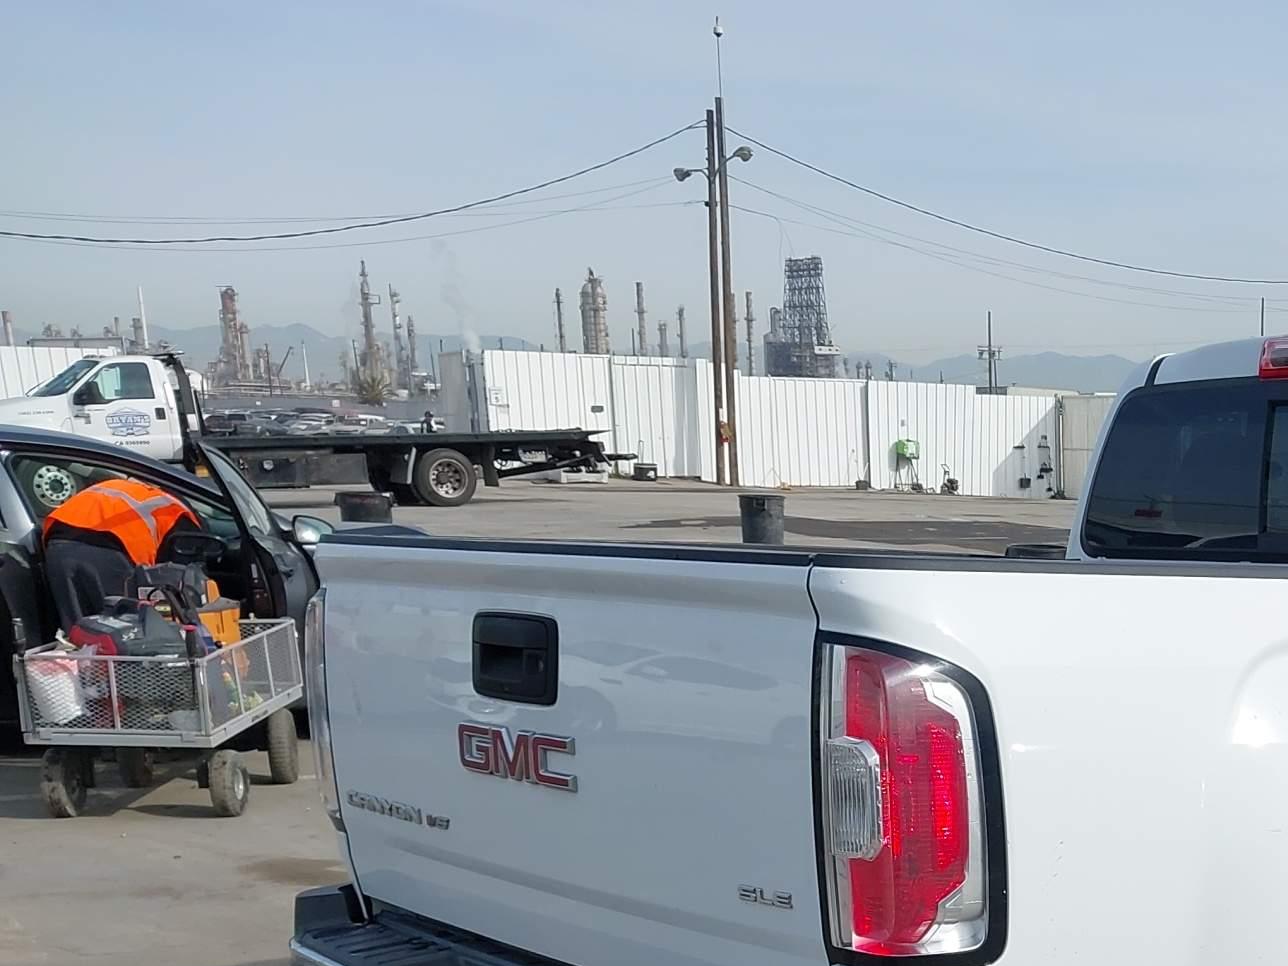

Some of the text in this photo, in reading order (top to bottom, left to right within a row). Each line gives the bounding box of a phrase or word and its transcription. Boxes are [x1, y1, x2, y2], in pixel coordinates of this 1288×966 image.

[457, 719, 579, 793] GMC
[347, 789, 450, 830] CANYON V6
[737, 883, 794, 911] SLE
